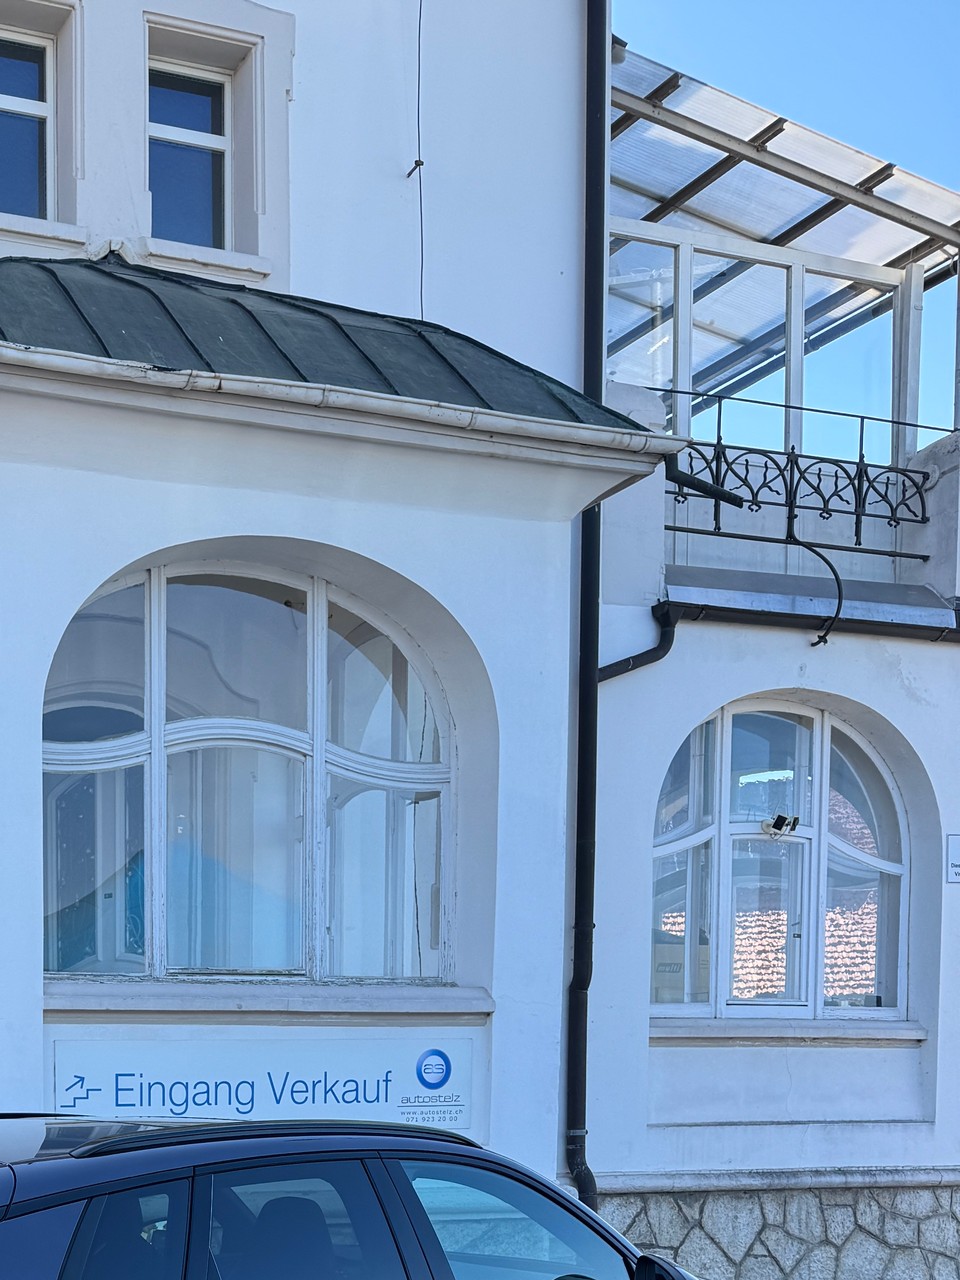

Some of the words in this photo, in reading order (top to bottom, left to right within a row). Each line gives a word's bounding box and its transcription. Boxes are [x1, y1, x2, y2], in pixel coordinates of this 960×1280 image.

[115, 1073, 254, 1115] Eingang
[267, 1070, 392, 1106] Verkauf
[401, 1093, 461, 1104] autostelz
